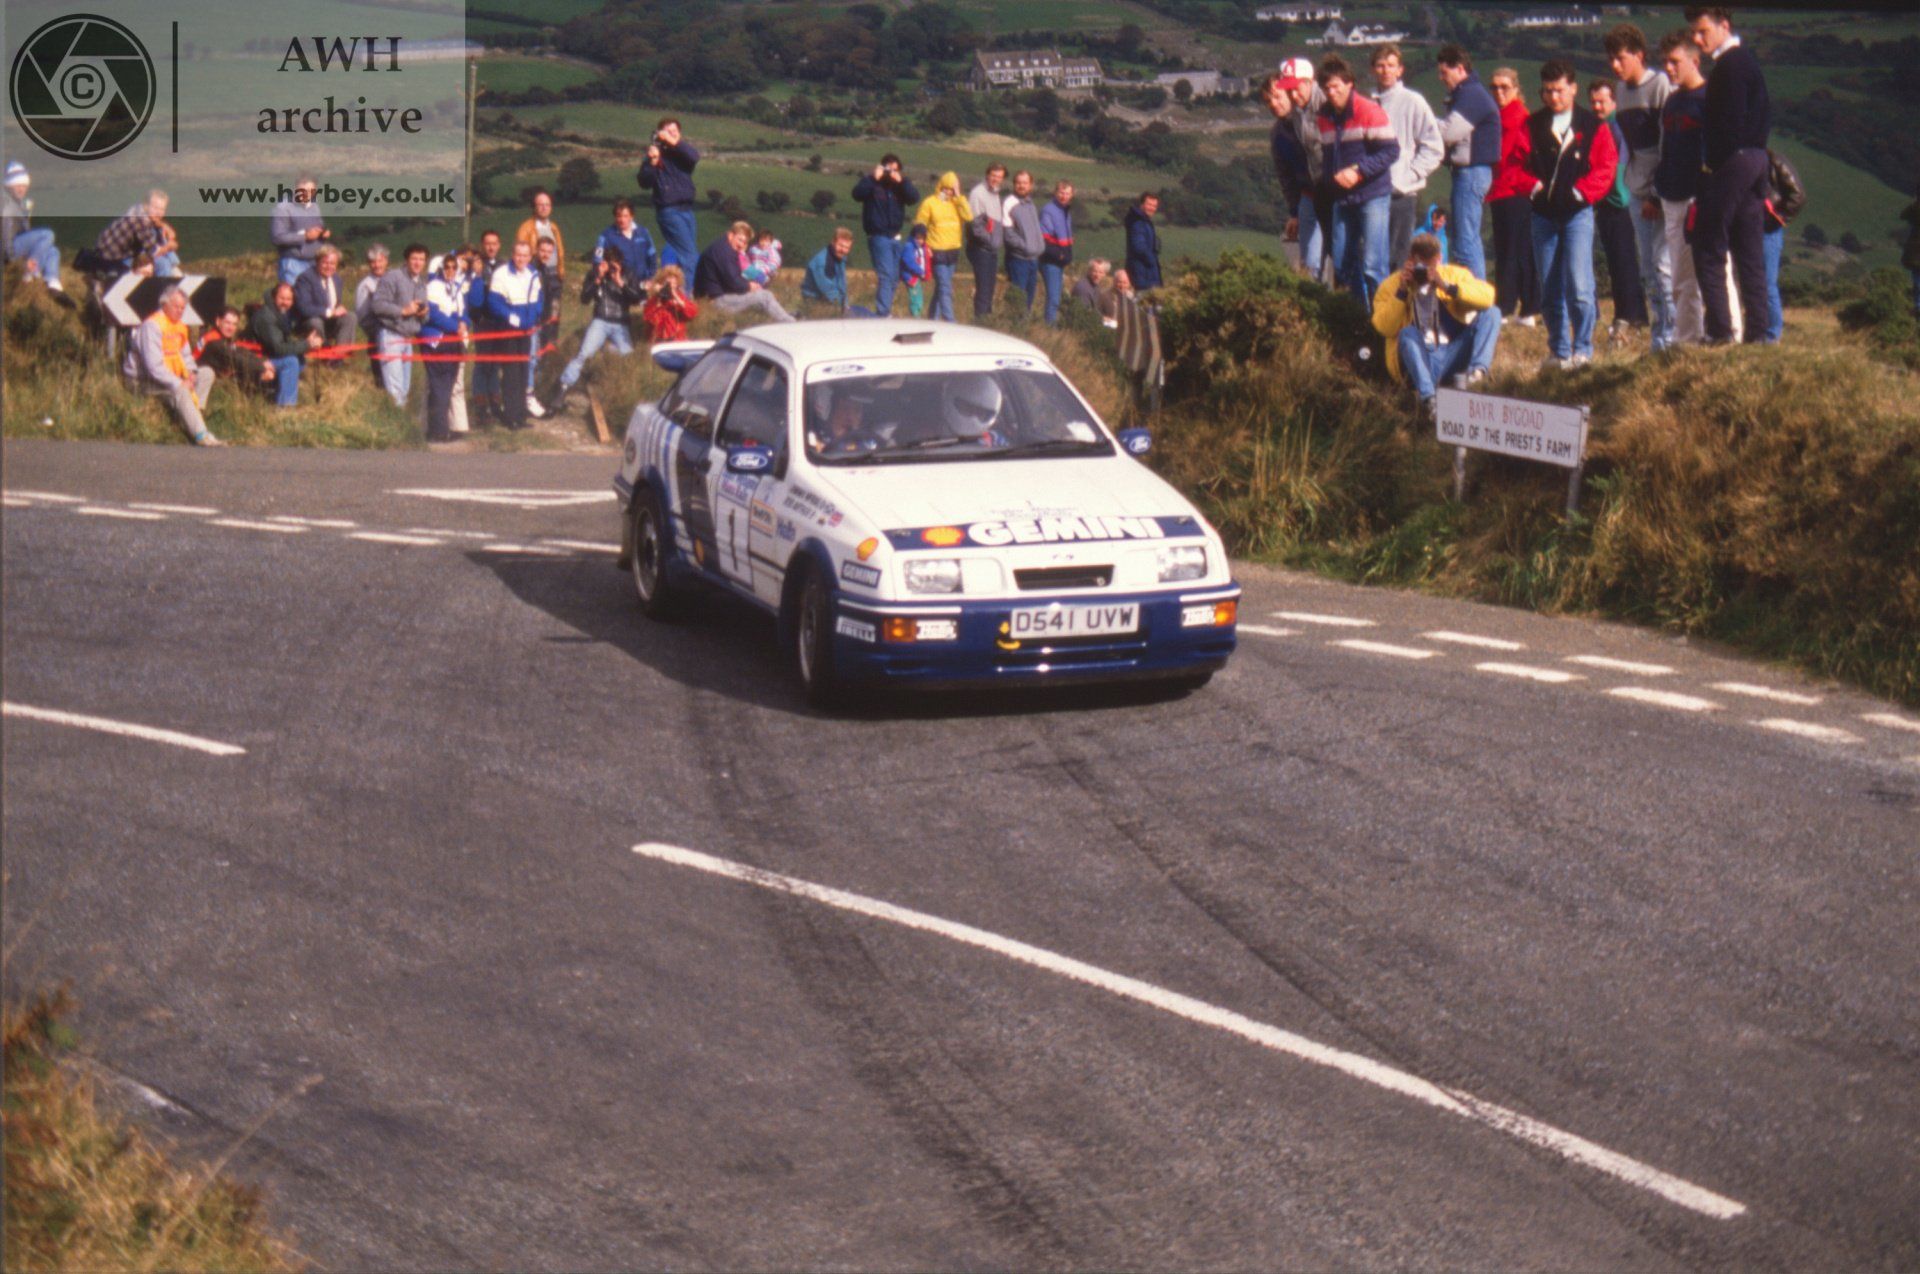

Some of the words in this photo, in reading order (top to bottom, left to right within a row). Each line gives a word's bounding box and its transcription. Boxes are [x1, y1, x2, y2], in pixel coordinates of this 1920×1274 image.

[1469, 400, 1495, 421] BAYR
[1502, 404, 1544, 431] BYGOAD
[1441, 420, 1465, 438] ROAD
[1468, 425, 1480, 440] OF
[1484, 428, 1500, 445] THE
[1505, 431, 1542, 453] PRIEST'S
[1546, 439, 1572, 459] FARM
[967, 516, 1165, 546] GEMINI
[1015, 609, 1074, 632] D541
[1085, 607, 1134, 628] UVW
